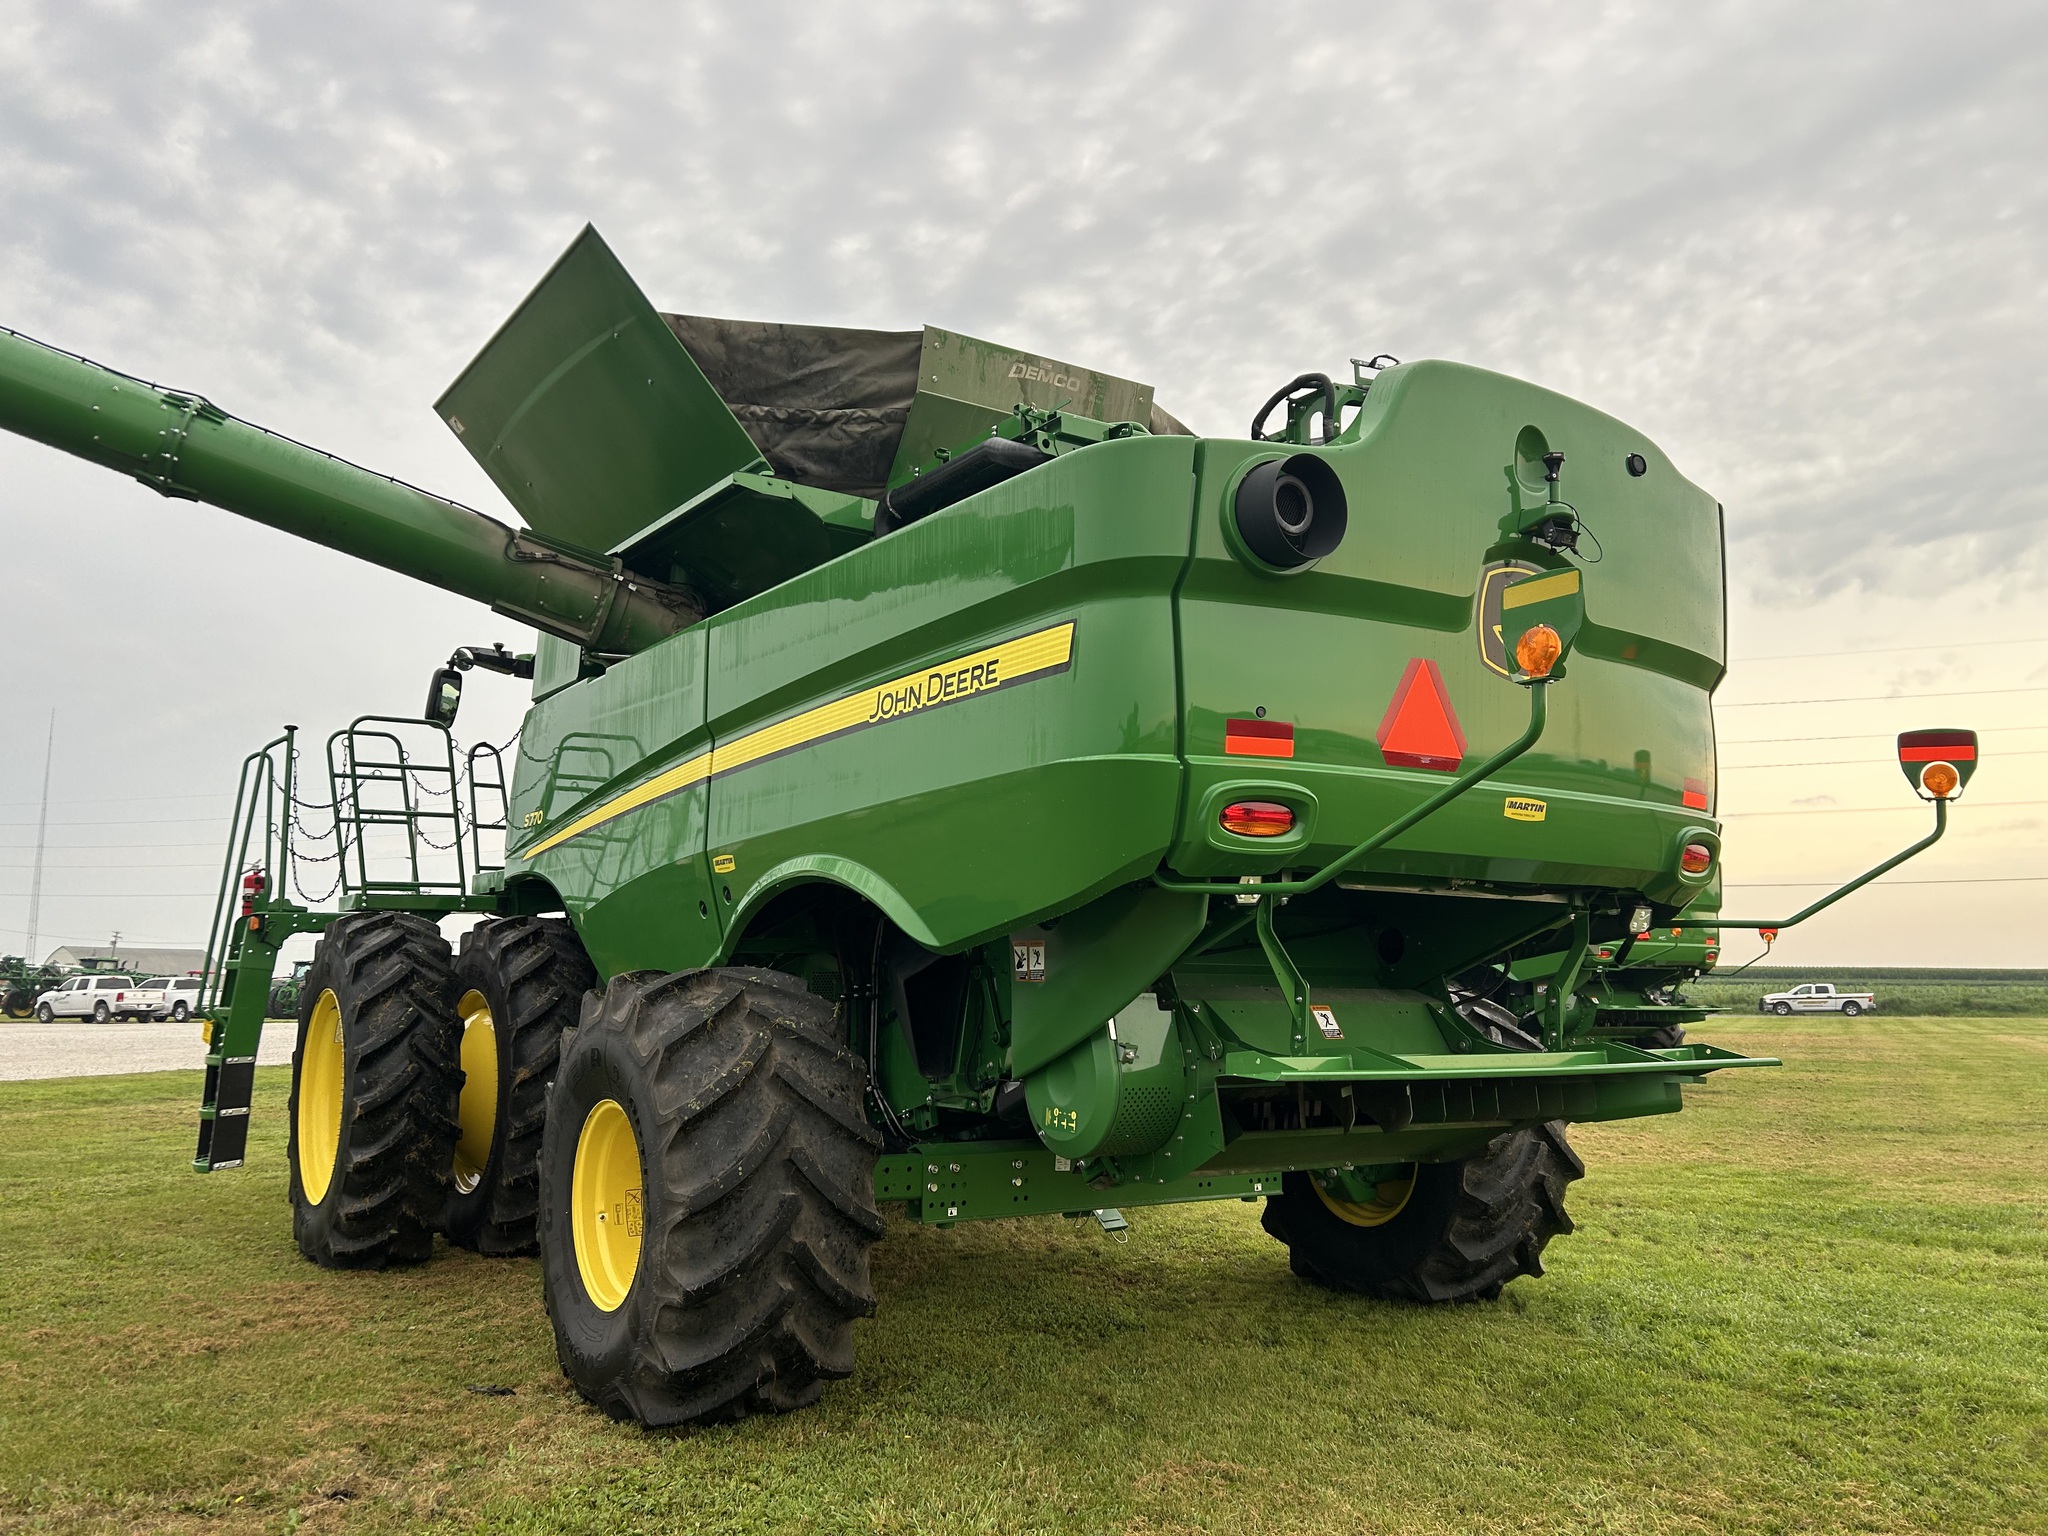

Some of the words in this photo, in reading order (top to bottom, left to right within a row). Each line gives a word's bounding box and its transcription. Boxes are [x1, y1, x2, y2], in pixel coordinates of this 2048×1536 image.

[1008, 362, 1081, 391] DEMCO
[869, 682, 923, 720] JOHN
[927, 658, 1000, 703] DEERE
[1507, 801, 1545, 812] MARTIN
[524, 810, 544, 828] S770
